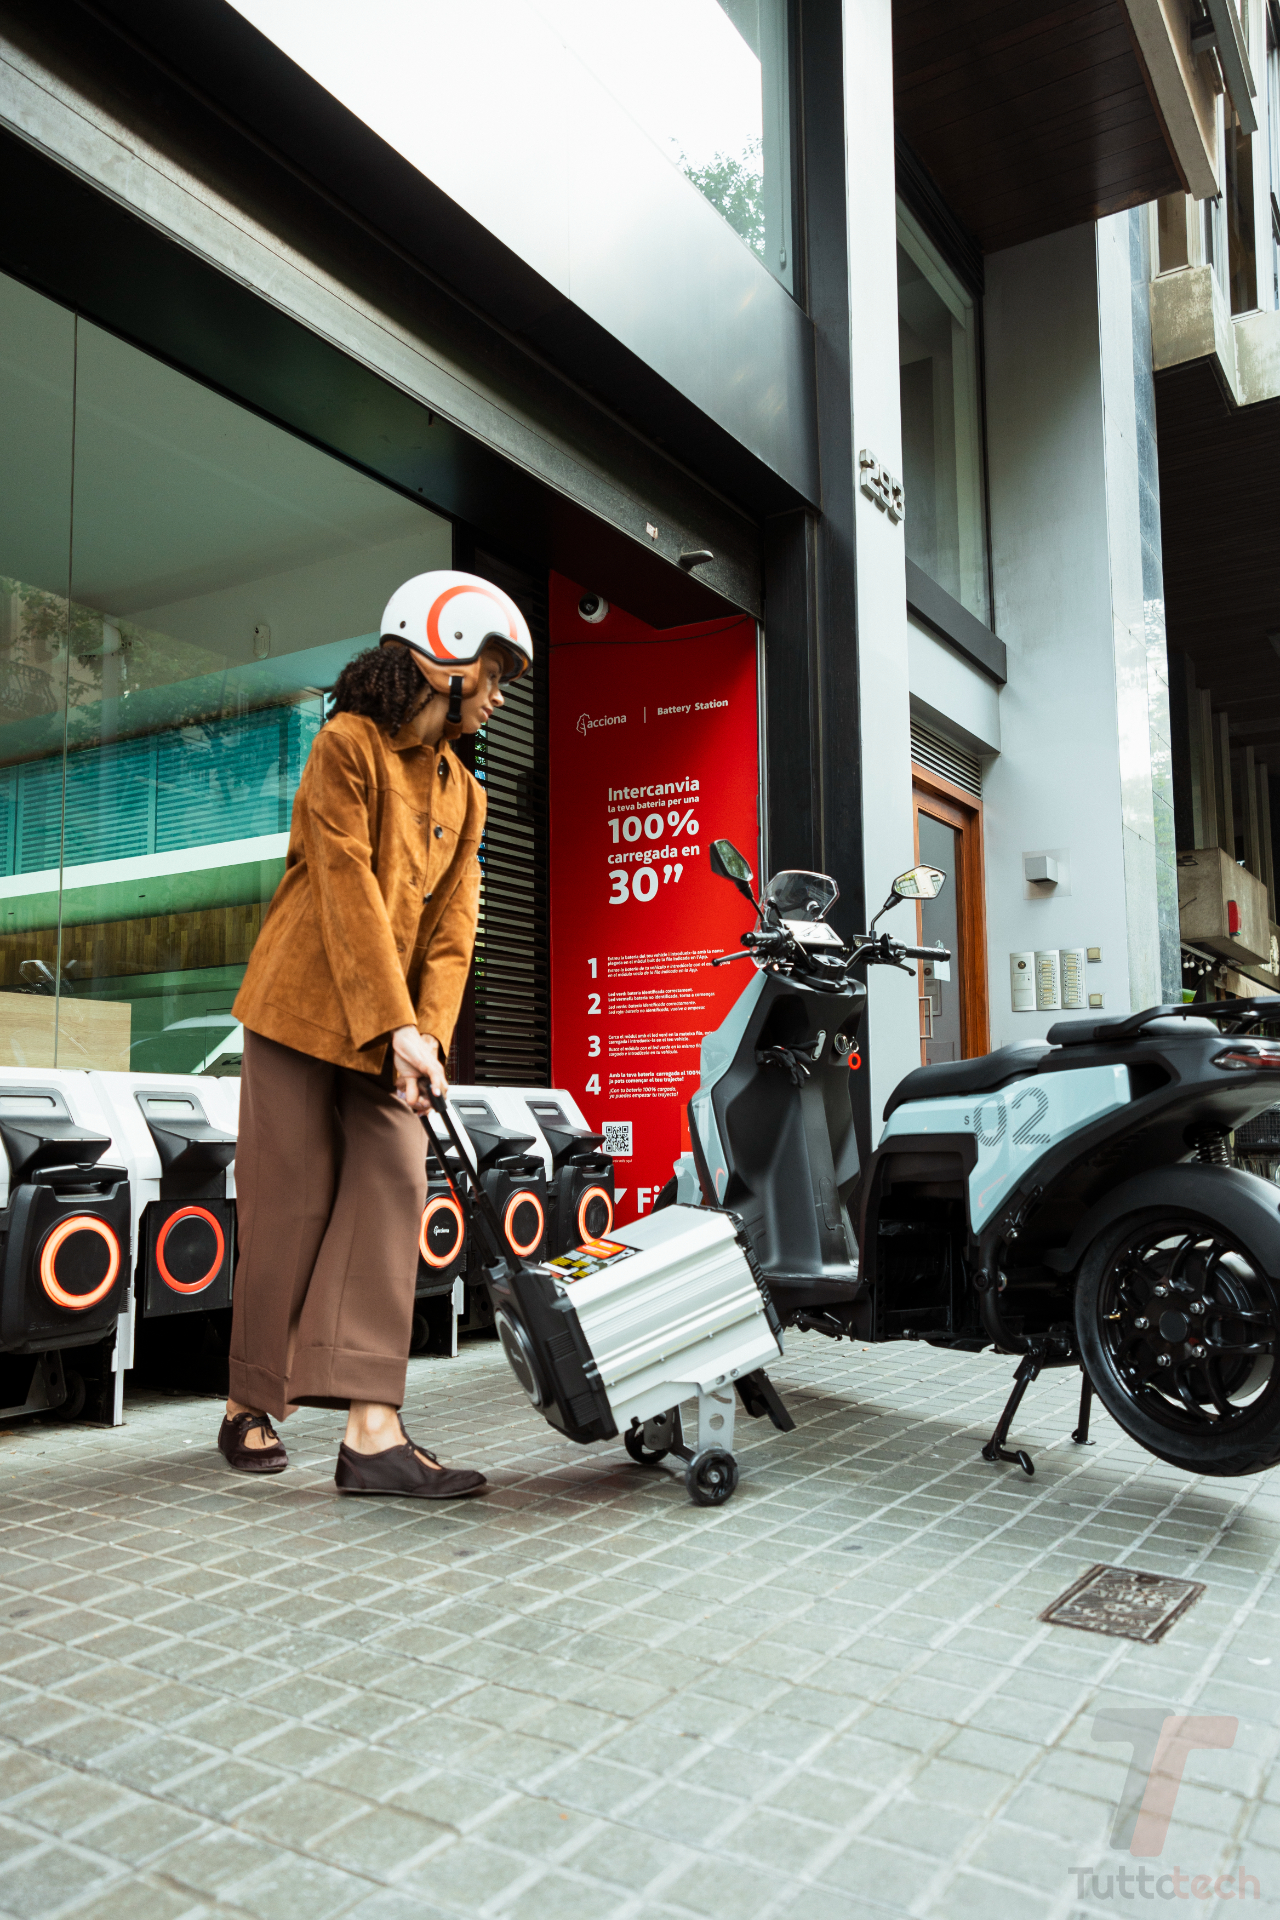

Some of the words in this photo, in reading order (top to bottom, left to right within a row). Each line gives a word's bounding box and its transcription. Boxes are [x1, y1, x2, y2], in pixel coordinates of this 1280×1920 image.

[859, 448, 905, 521] 293
[587, 713, 627, 729] acciona
[657, 703, 691, 716] Battery
[694, 698, 729, 711] Station
[608, 776, 700, 802] Intercanvia
[608, 804, 616, 813] la
[617, 802, 635, 812] teva
[636, 798, 666, 810] bateria
[667, 796, 682, 808] per
[683, 795, 700, 804] una
[608, 808, 700, 844] 100%
[608, 845, 678, 865] carregada
[681, 844, 700, 857] en
[587, 957, 598, 979] 1
[587, 993, 601, 1015] 2
[587, 1035, 601, 1058] 3
[585, 1074, 601, 1095] 4
[637, 1185, 665, 1213] Fi
